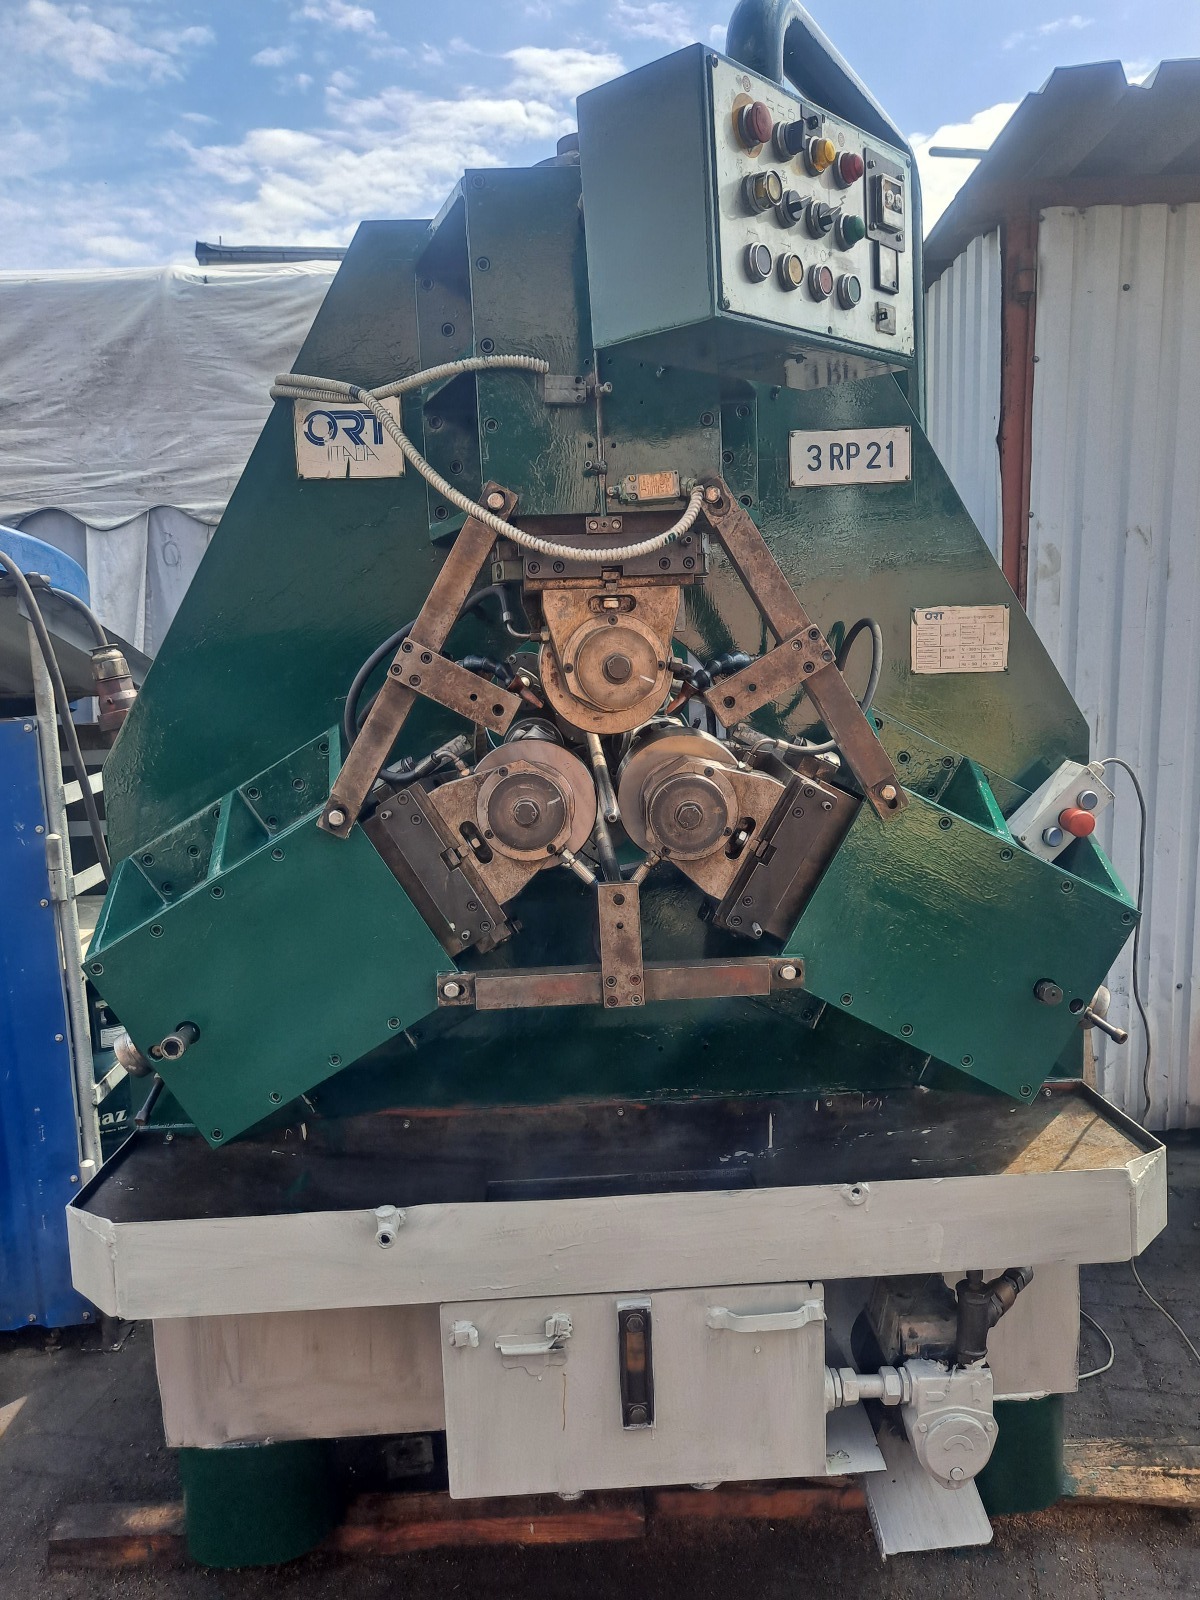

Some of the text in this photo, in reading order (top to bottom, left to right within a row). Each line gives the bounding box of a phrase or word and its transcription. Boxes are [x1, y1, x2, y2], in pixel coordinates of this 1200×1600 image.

[806, 440, 894, 472] 3 RP 21
